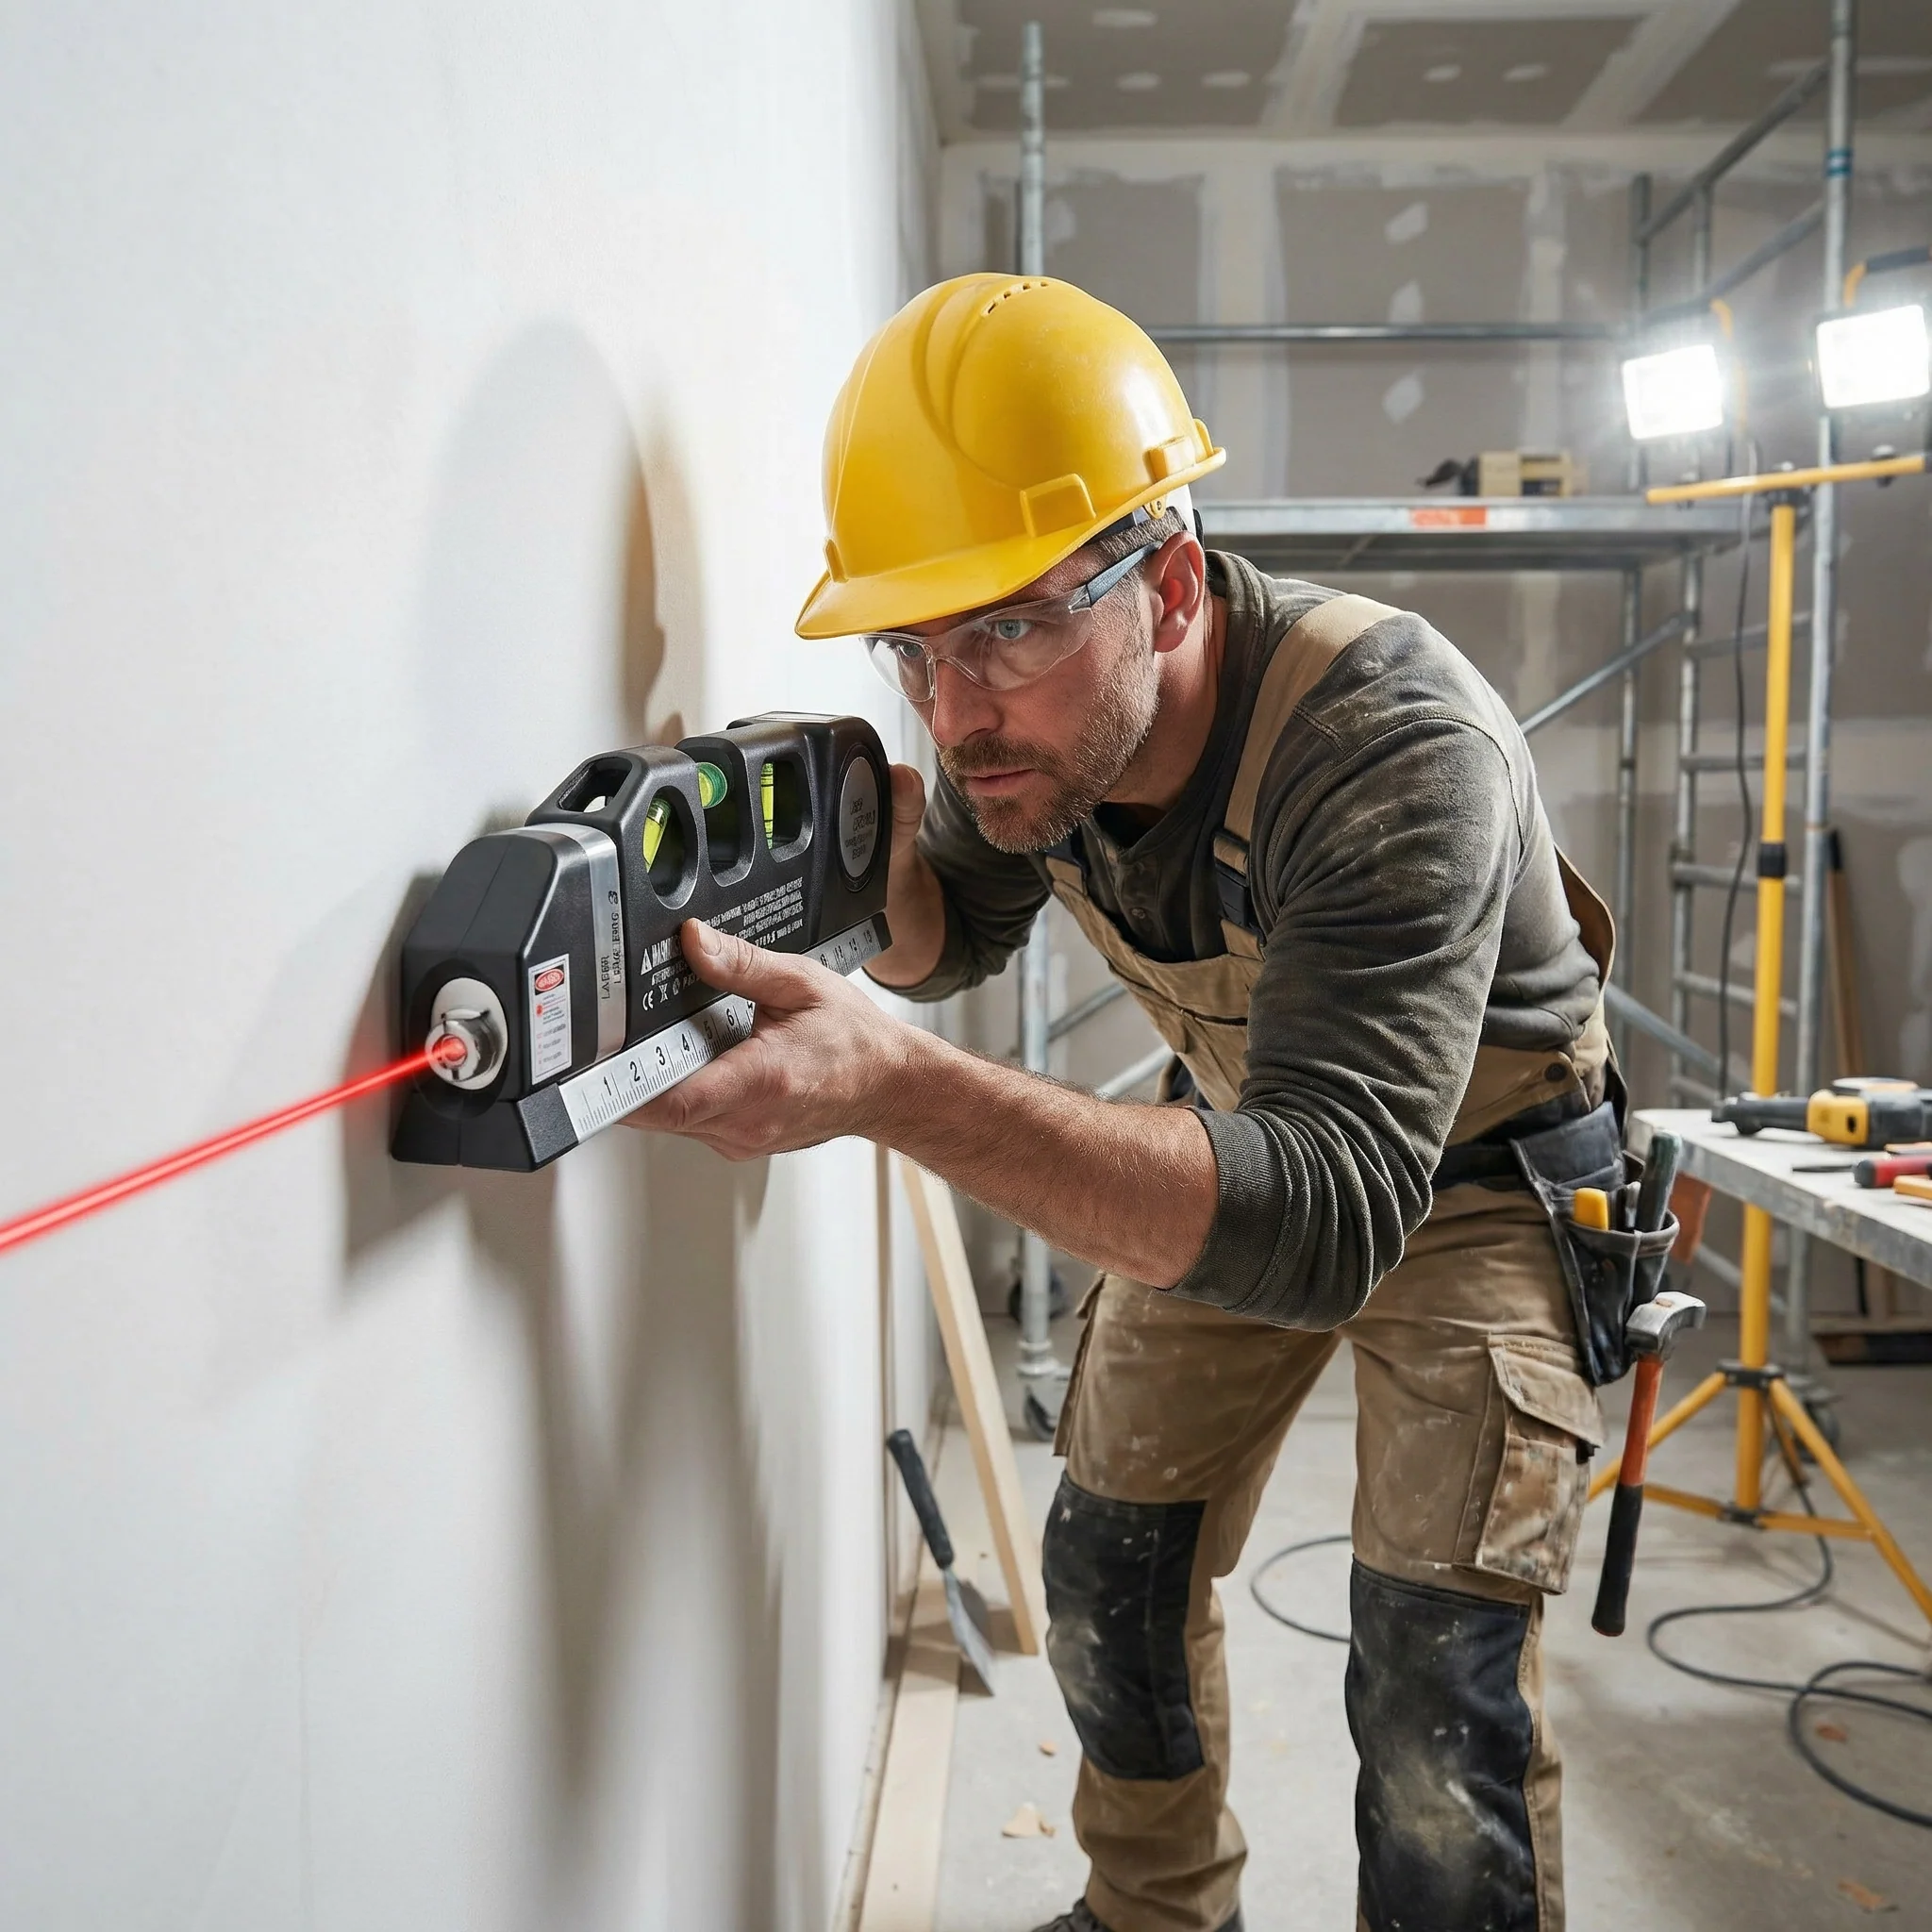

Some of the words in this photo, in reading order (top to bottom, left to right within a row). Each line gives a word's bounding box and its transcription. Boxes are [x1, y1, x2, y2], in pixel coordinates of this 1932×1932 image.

[603, 1076, 612, 1096] 1
[629, 1060, 641, 1082] 2
[656, 1046, 666, 1066] 3
[682, 1033, 691, 1052] 4
[703, 1020, 713, 1040] 5
[725, 1008, 735, 1026] 6
